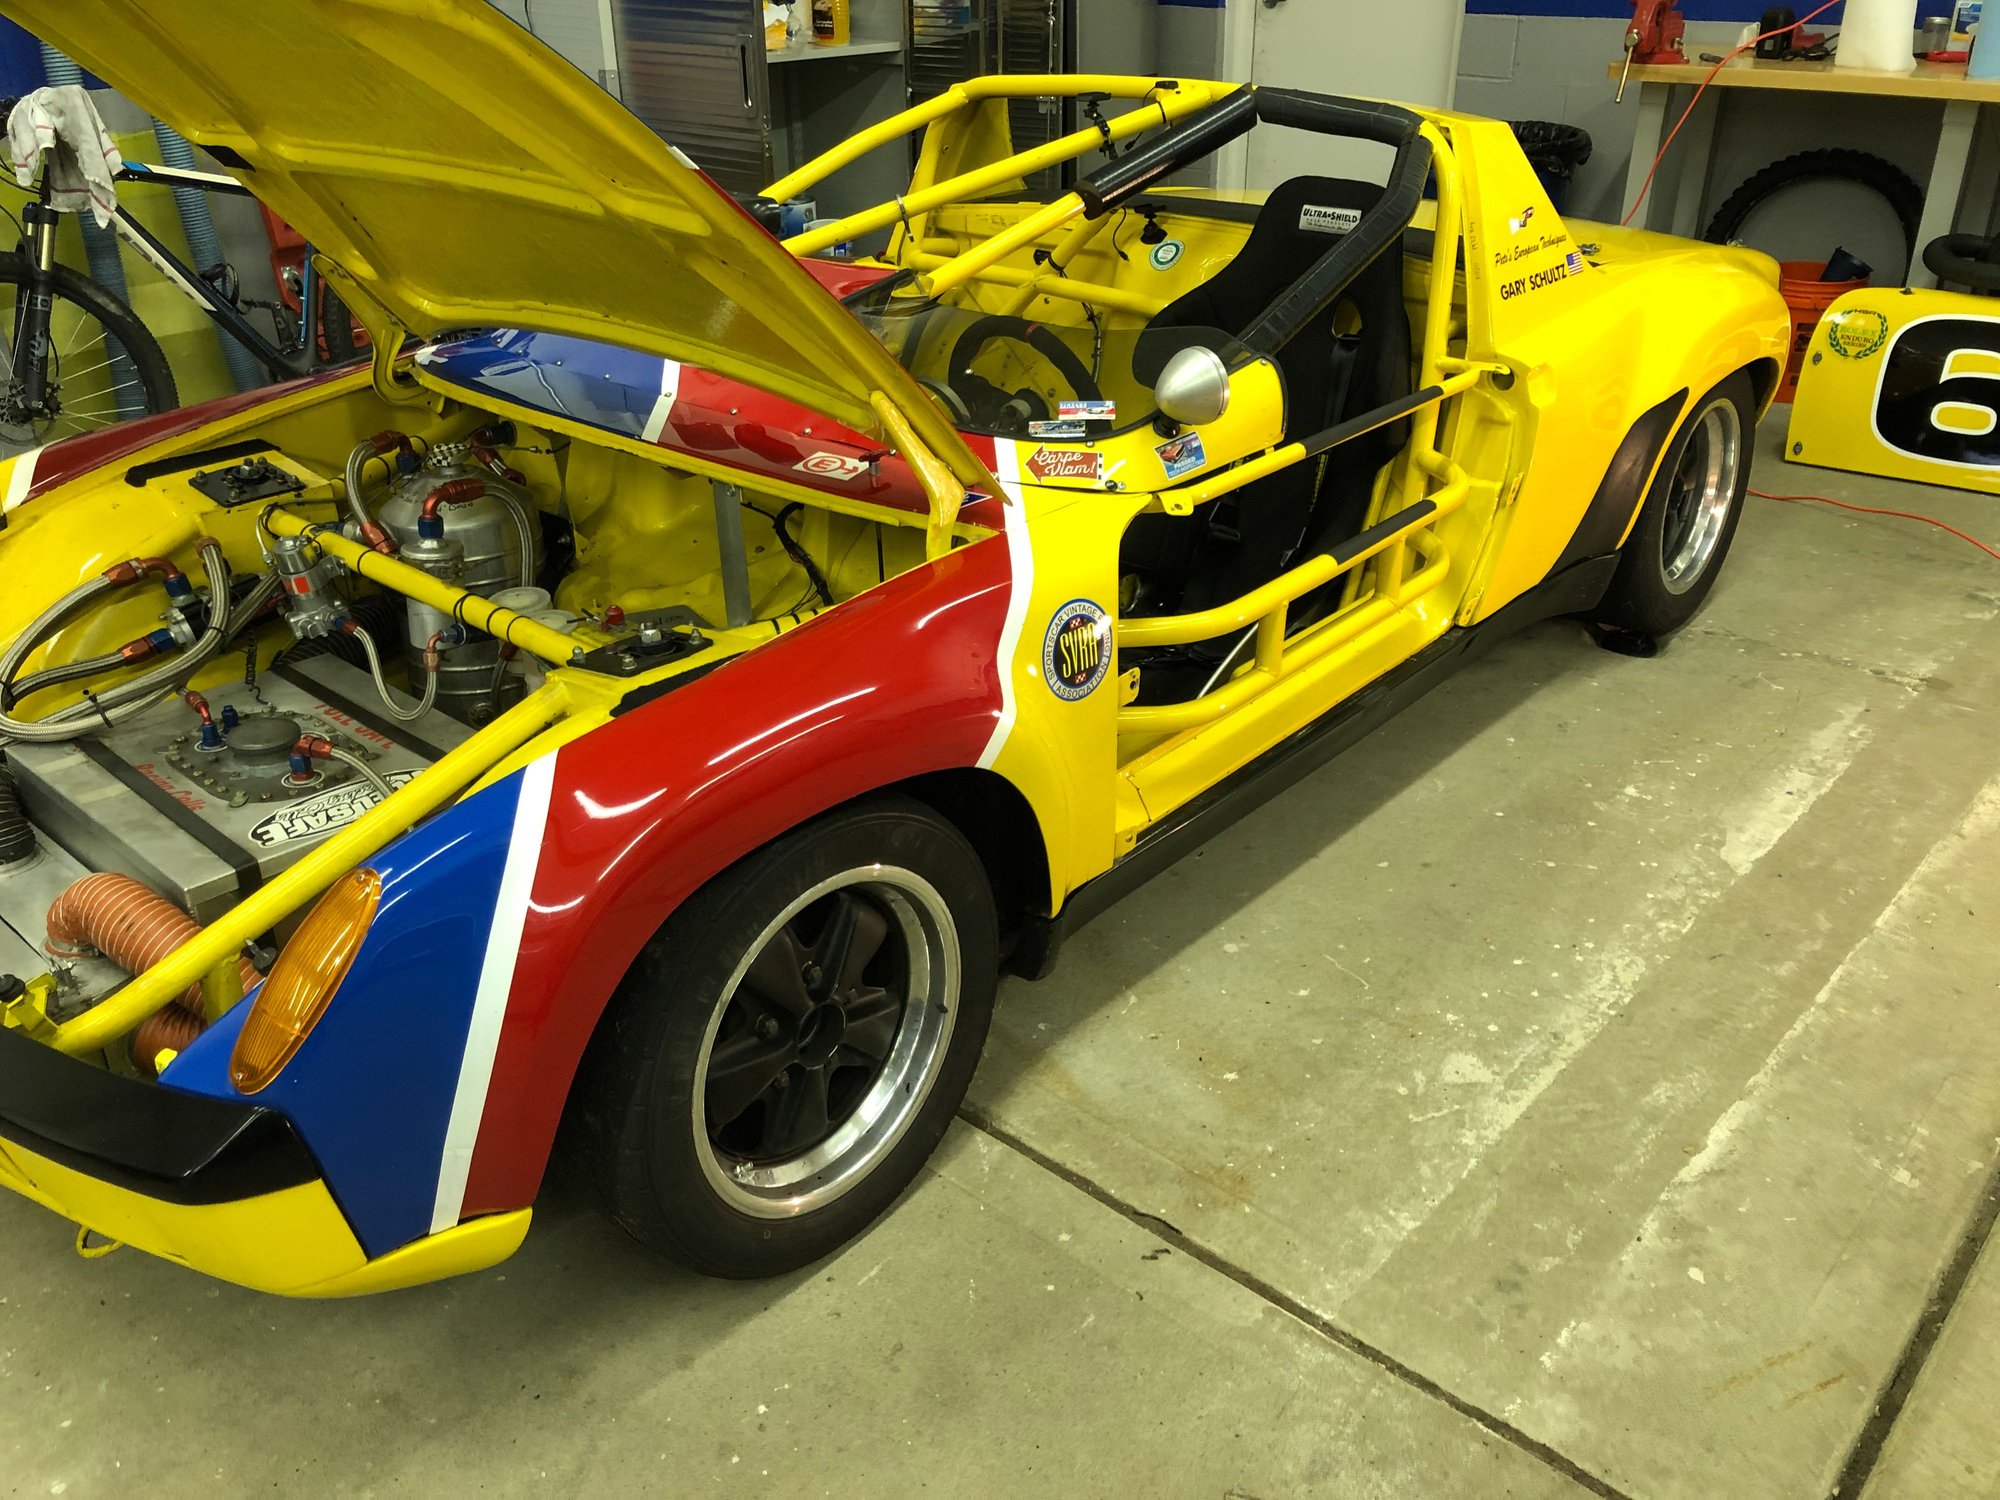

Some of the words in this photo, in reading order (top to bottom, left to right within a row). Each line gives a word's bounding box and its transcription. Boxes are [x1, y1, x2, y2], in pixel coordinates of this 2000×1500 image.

[1514, 245, 1539, 261] European
[1500, 278, 1526, 300] GARY
[1529, 263, 1567, 291] SCHULTZ
[1840, 334, 1875, 344] ENDURO
[1034, 451, 1083, 465] Carpe
[1174, 456, 1196, 469] PASSED
[1044, 462, 1096, 477] Viam!
[1046, 615, 1064, 680] SPORTSCAR
[1064, 604, 1097, 617] VINTAGE
[1060, 622, 1098, 678] SVRA
[1056, 661, 1109, 699] ASSOCIATION
